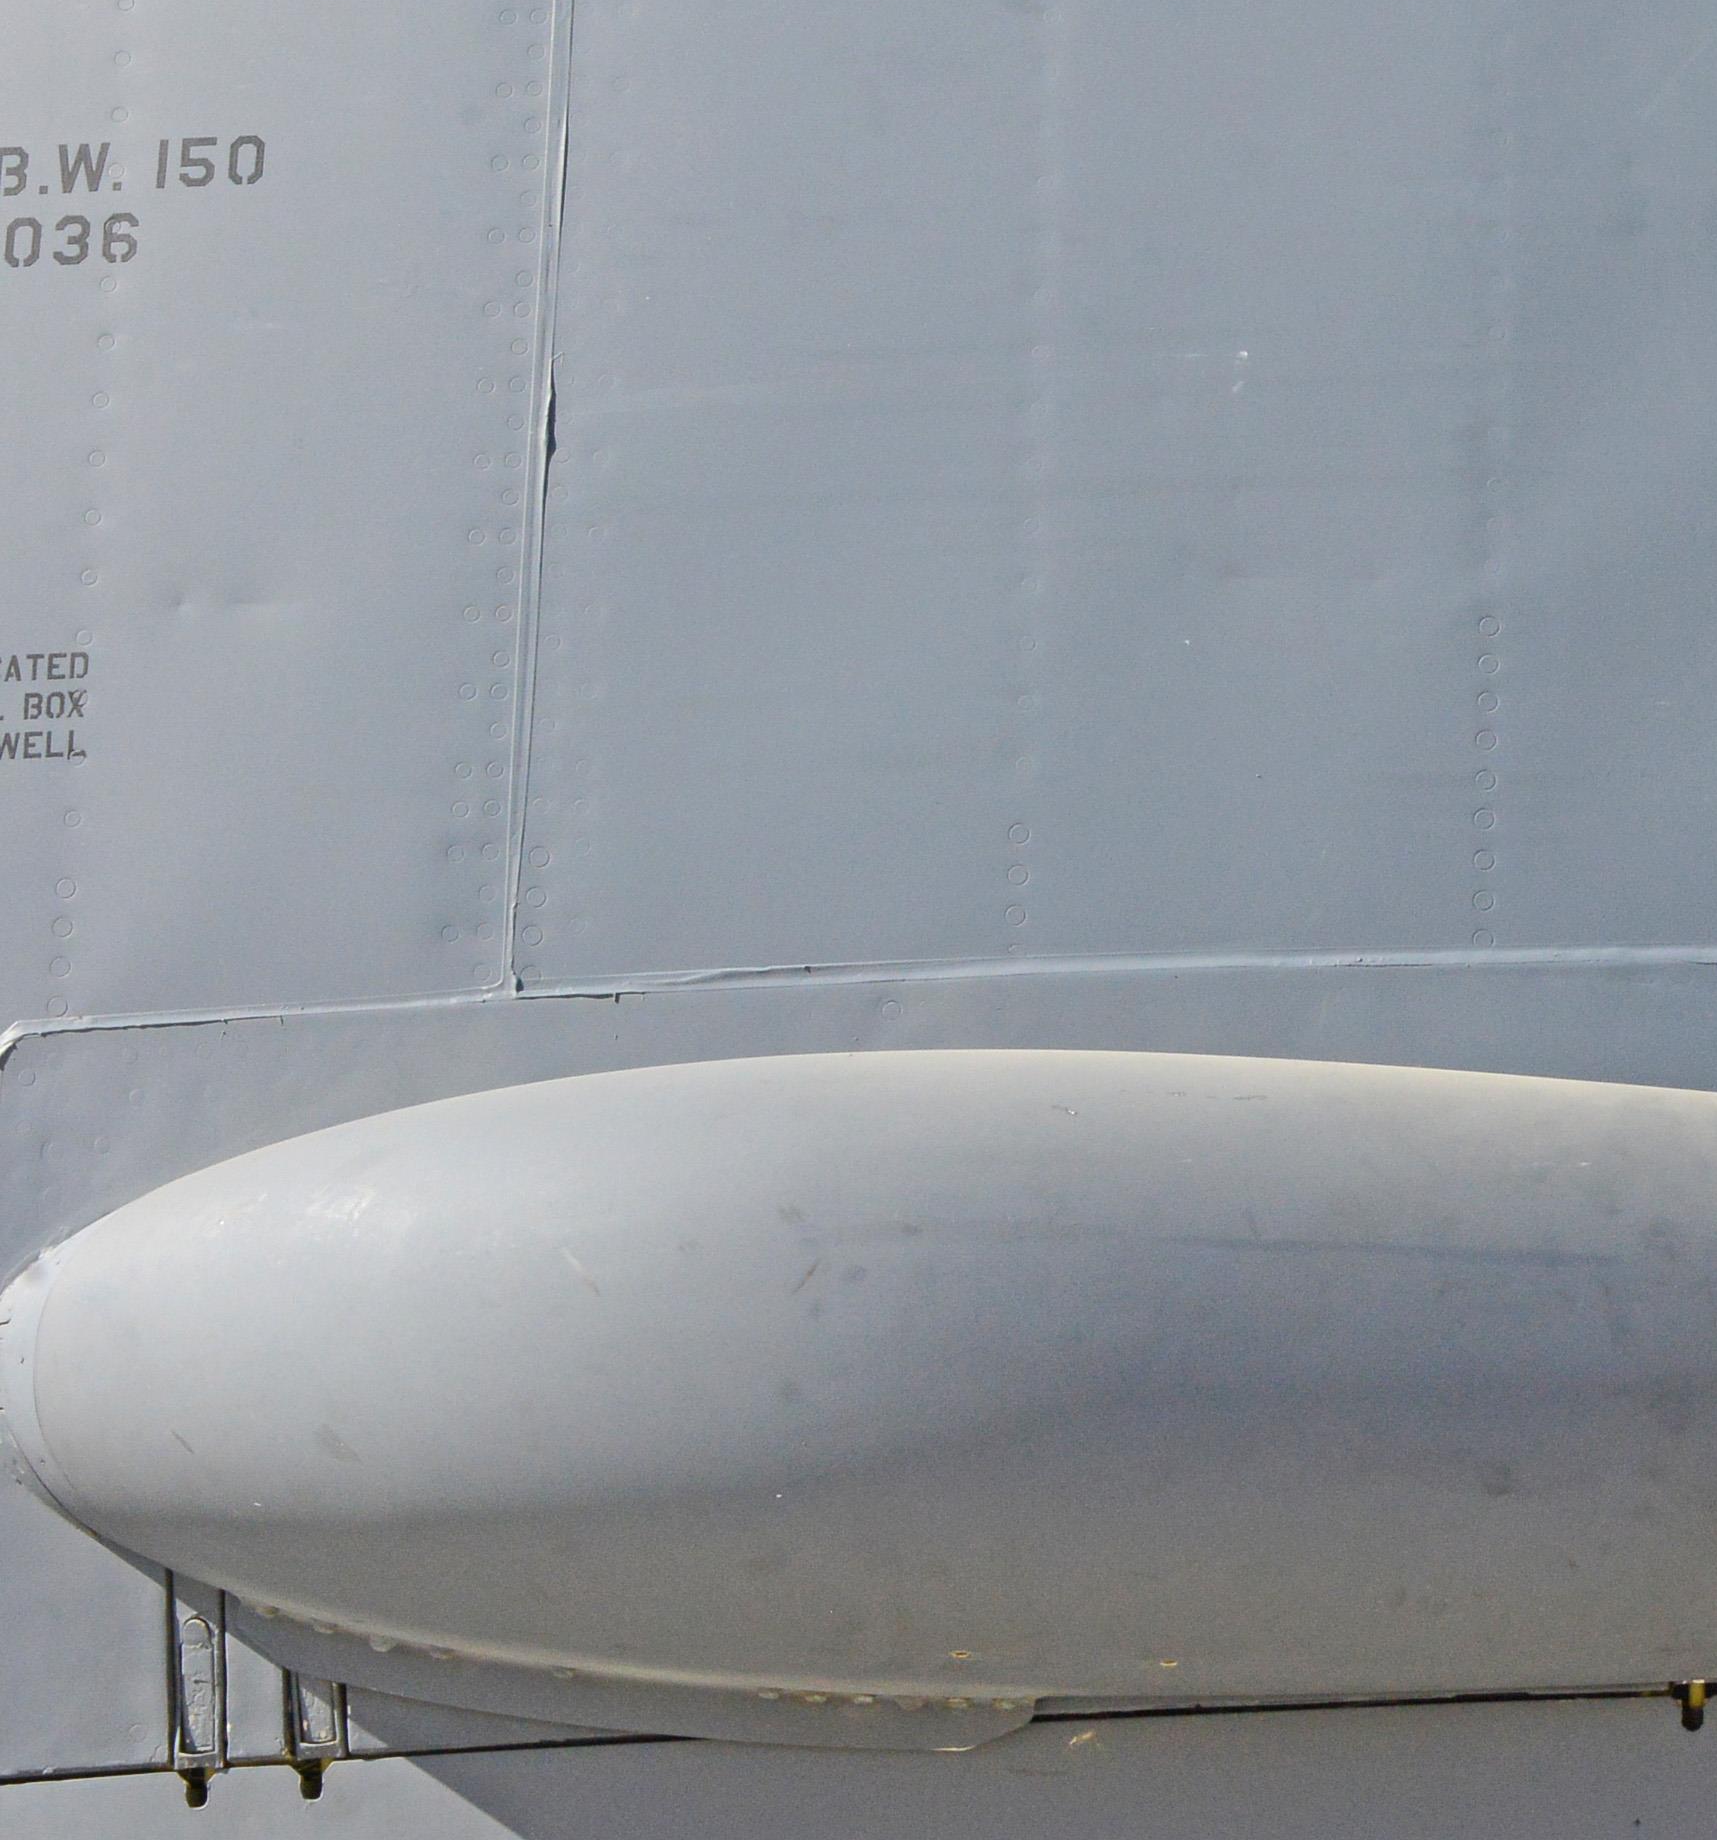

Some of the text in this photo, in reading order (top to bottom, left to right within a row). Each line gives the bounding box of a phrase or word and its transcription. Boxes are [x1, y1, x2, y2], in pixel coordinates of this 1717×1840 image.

[156, 135, 265, 188] 150
[4, 213, 139, 268] 036
[0, 652, 89, 682] ATED
[23, 690, 87, 720] BOX
[0, 730, 87, 760] WELL
